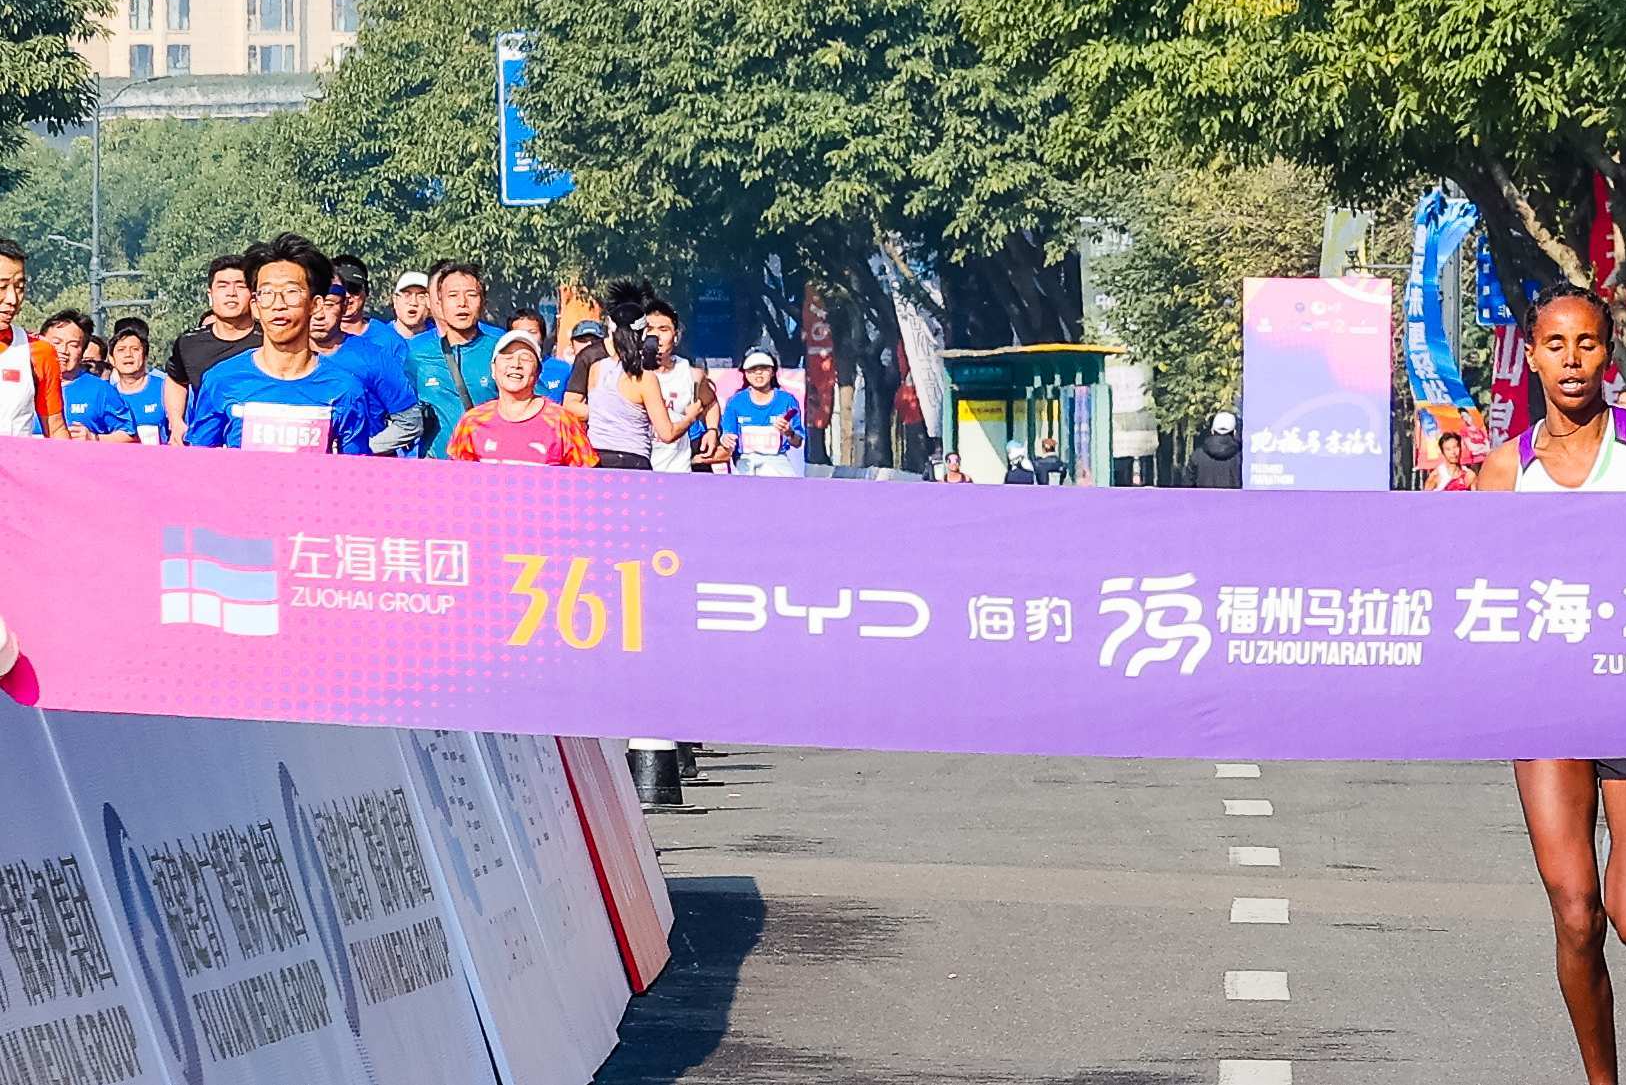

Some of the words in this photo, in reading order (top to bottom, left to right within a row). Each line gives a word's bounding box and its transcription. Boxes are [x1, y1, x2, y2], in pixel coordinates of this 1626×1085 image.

[288, 531, 470, 587] 左海集团
[290, 586, 374, 612] ZUOHAI
[379, 591, 456, 617] GROUP
[696, 581, 931, 638] BYD
[967, 595, 1074, 644] 海豹
[1216, 584, 1434, 637] 福州马拉松
[1227, 639, 1424, 667] FUZHOUMARATHON
[277, 956, 334, 1032] GROUP
